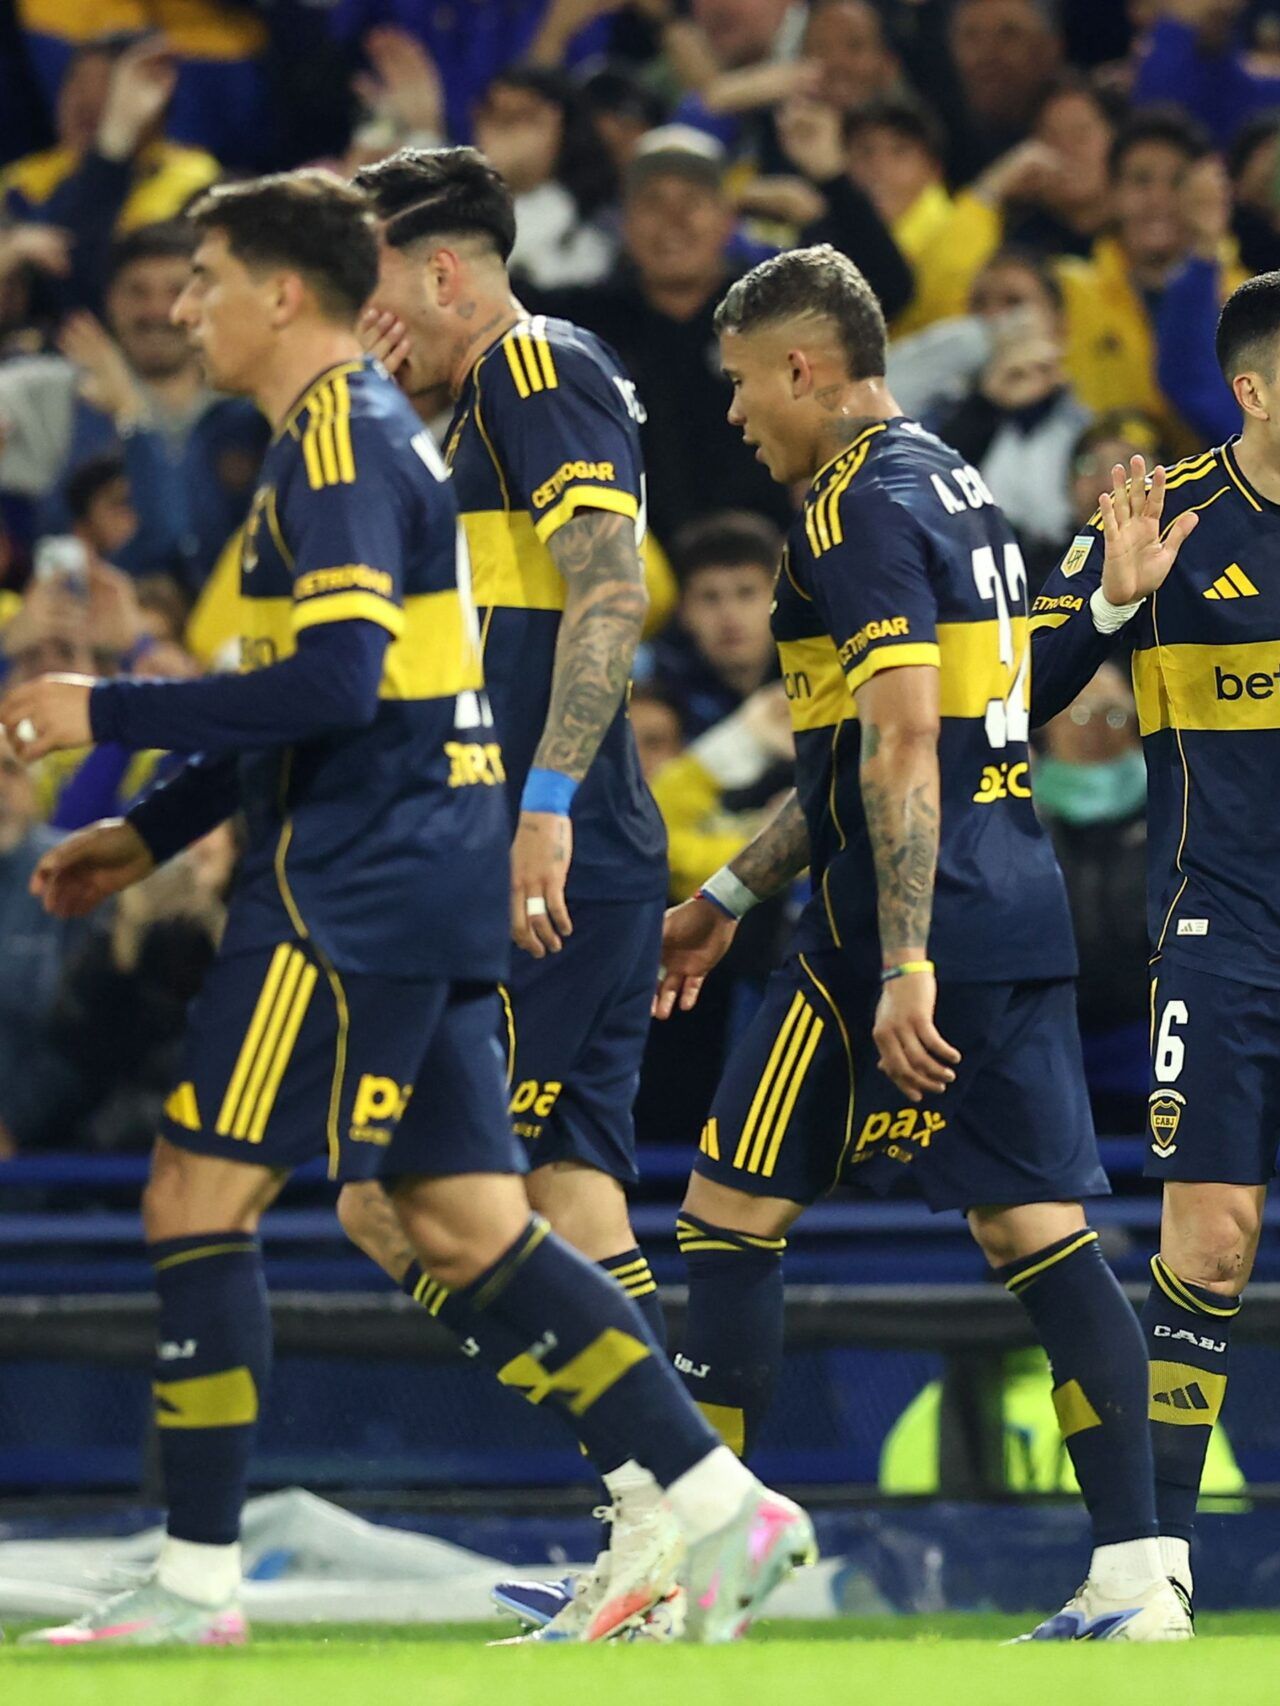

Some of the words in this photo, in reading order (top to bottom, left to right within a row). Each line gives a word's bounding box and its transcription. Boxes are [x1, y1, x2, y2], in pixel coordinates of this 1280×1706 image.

[1155, 1000, 1189, 1082] 6
[855, 1107, 946, 1148] pax
[1155, 1115, 1175, 1127] CABJ
[1154, 1325, 1226, 1352] CABJ
